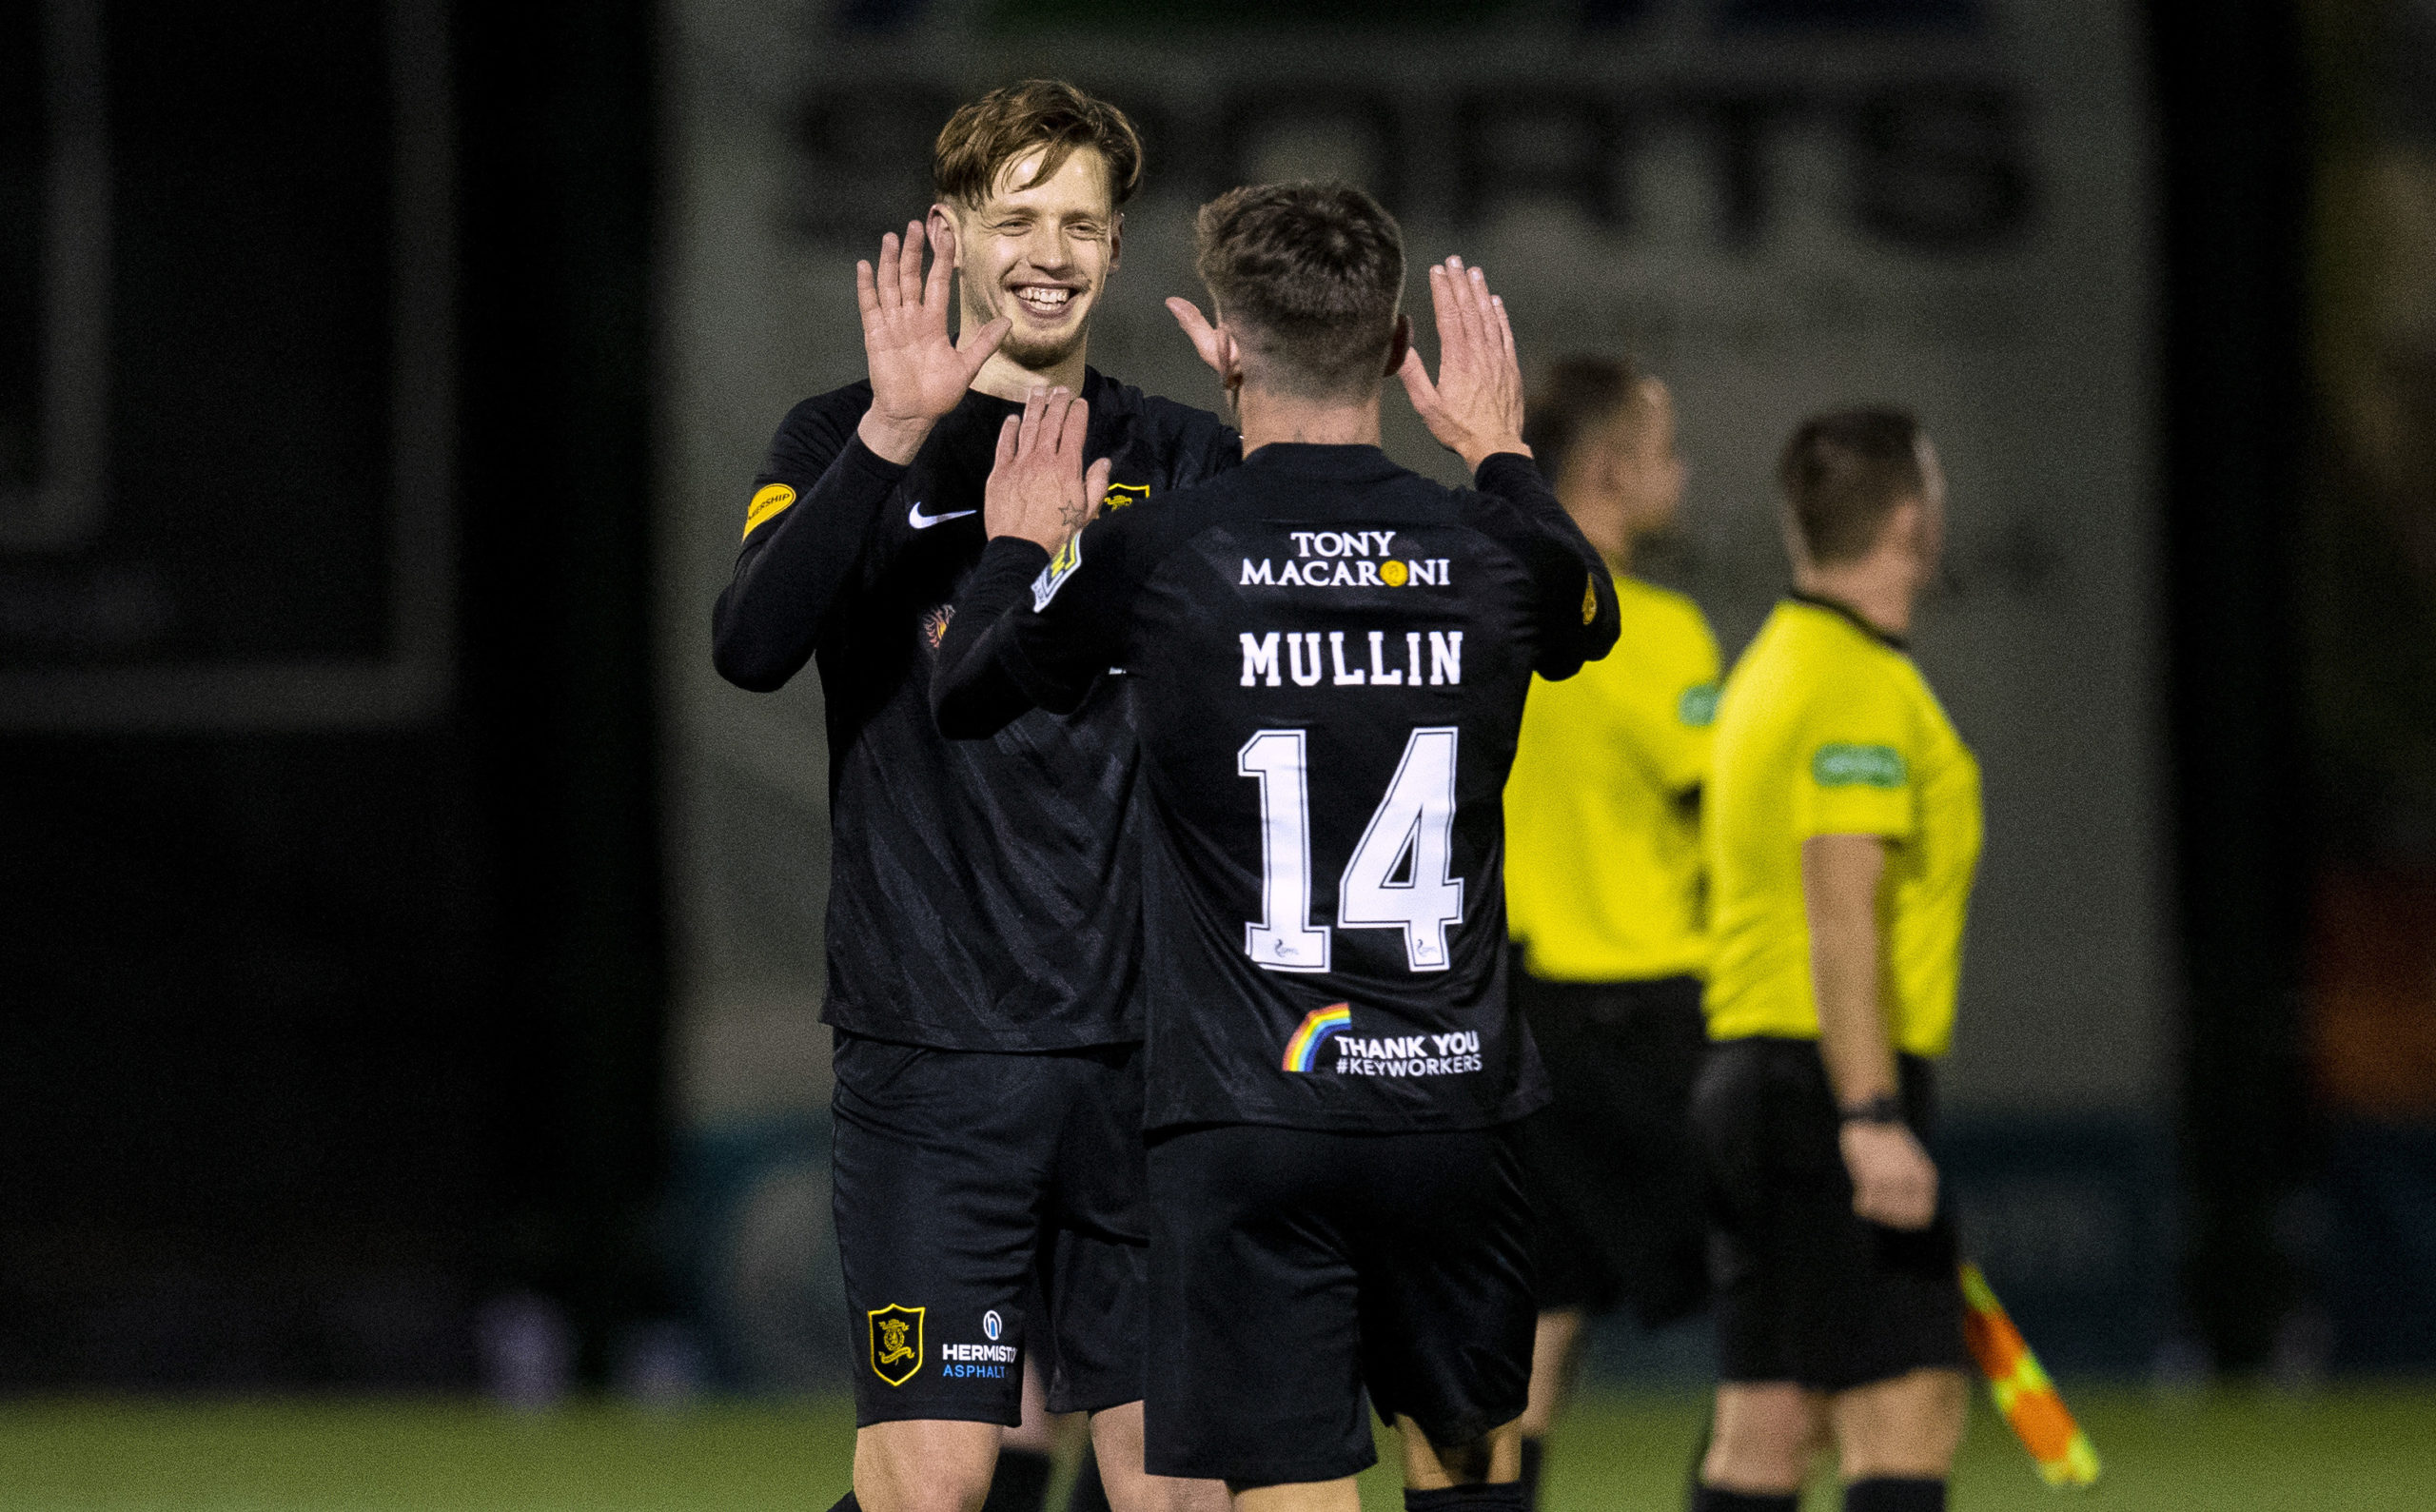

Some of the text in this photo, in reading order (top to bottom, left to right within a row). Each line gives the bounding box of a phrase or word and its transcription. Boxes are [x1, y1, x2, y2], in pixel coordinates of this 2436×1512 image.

[788, 82, 2042, 257] SORTS
[1290, 531, 1396, 557] TONY
[1239, 558, 1450, 587] MACARONI
[1239, 631, 1463, 686] MULLIN
[1237, 726, 1464, 973] 14
[1334, 1030, 1480, 1060] THANK YOU
[1336, 1053, 1483, 1077] #KEYWORKERS
[943, 1364, 1005, 1378] ASPHALT
